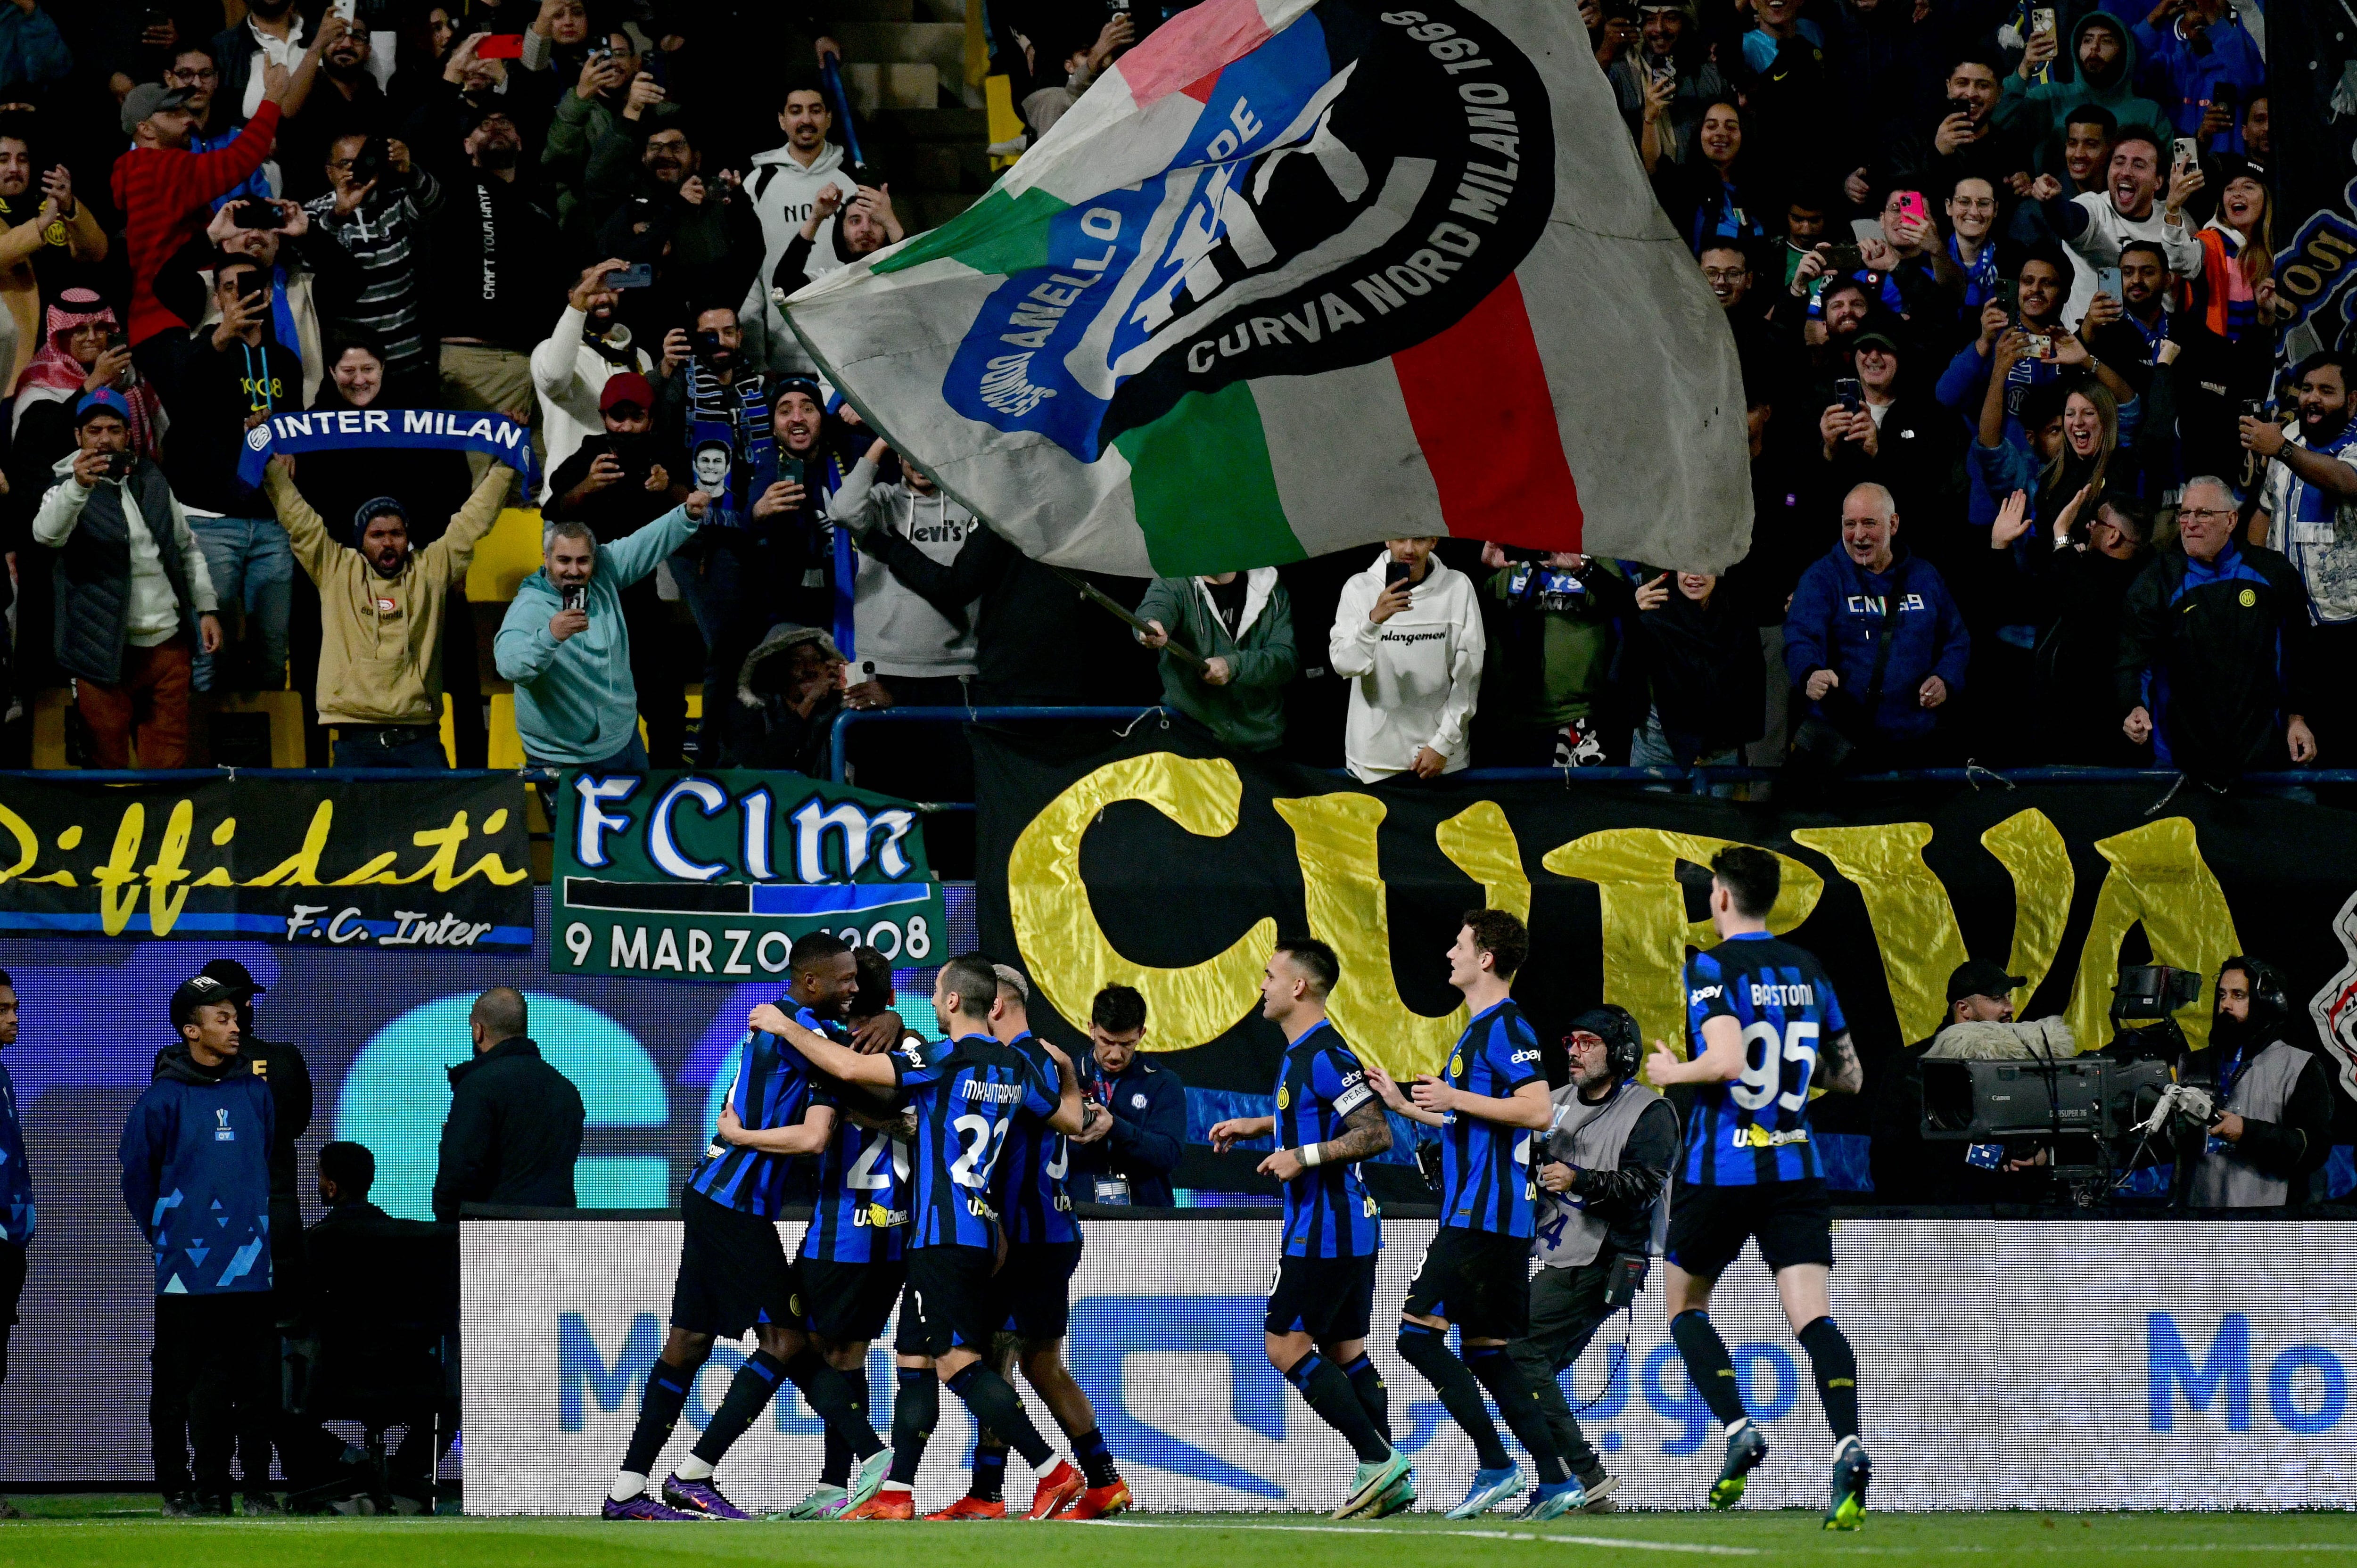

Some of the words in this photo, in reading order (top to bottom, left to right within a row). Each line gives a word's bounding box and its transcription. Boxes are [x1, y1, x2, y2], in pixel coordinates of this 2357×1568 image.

[1381, 11, 1493, 75] 1969
[1449, 83, 1519, 225] MILANO
[1000, 207, 1122, 348] ANELLO
[1352, 222, 1481, 315] NORD
[1187, 292, 1366, 374] CURVA
[240, 377, 283, 398] 1908
[273, 410, 395, 439] INTER
[404, 410, 523, 449] MILAN
[286, 904, 369, 944] F.C.
[379, 910, 492, 946] Inter
[1010, 750, 2242, 1089] CURVA
[565, 921, 593, 966] 9
[610, 925, 793, 975] MARZO
[1750, 983, 1814, 1007] BASTONI
[1342, 1070, 1365, 1087] eba
[1511, 1049, 1541, 1064] ebay
[1730, 1020, 1820, 1112] 95
[962, 1079, 1022, 1104] MKHITARYAN
